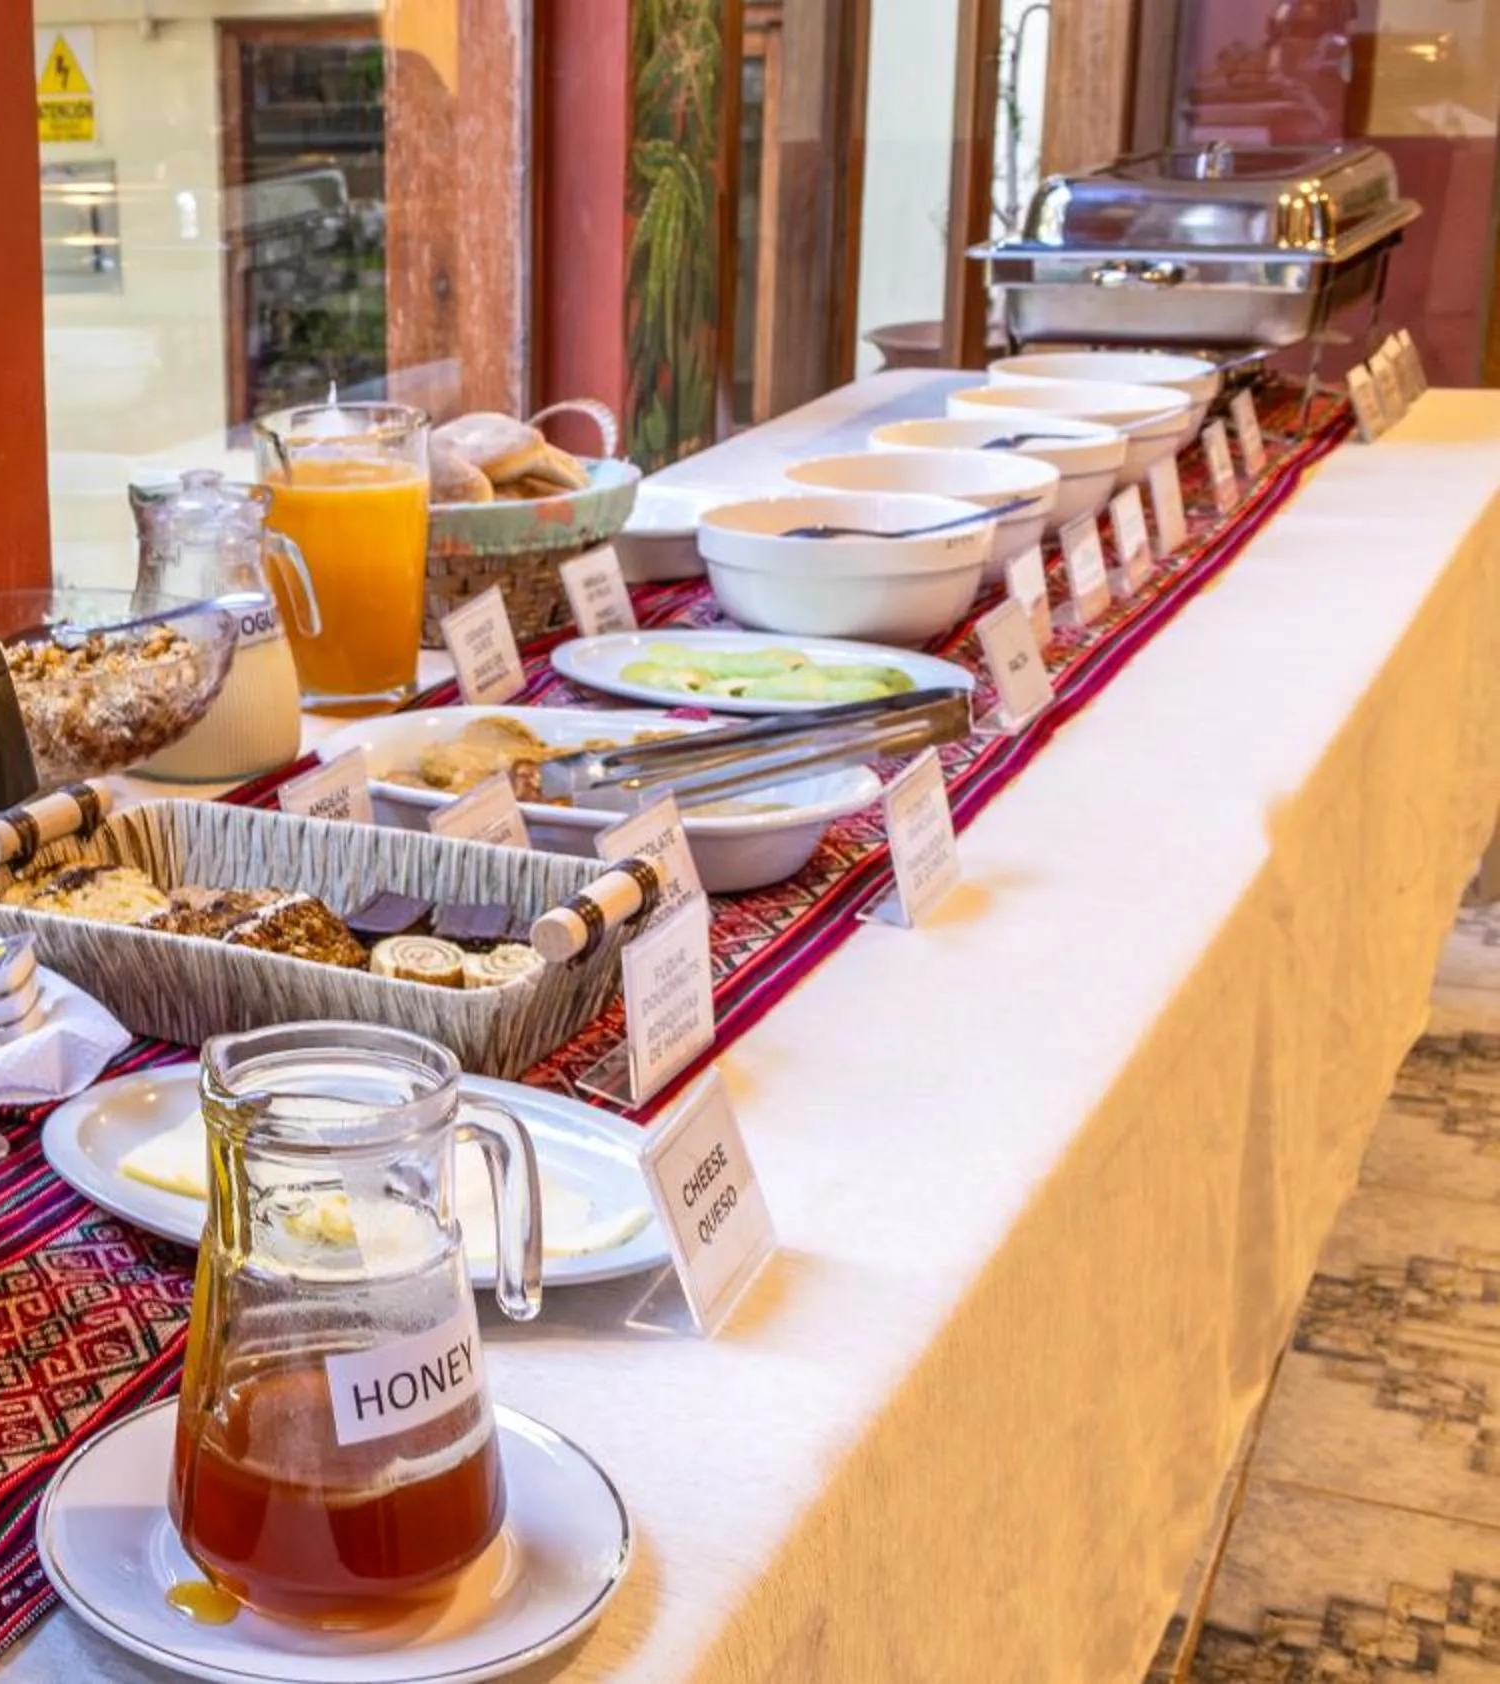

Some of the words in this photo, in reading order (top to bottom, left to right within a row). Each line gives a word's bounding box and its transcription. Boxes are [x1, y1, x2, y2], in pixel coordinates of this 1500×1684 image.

[682, 1141, 728, 1208] CHEESE
[697, 1184, 737, 1246] QUESO
[352, 1334, 474, 1421] HONEY
